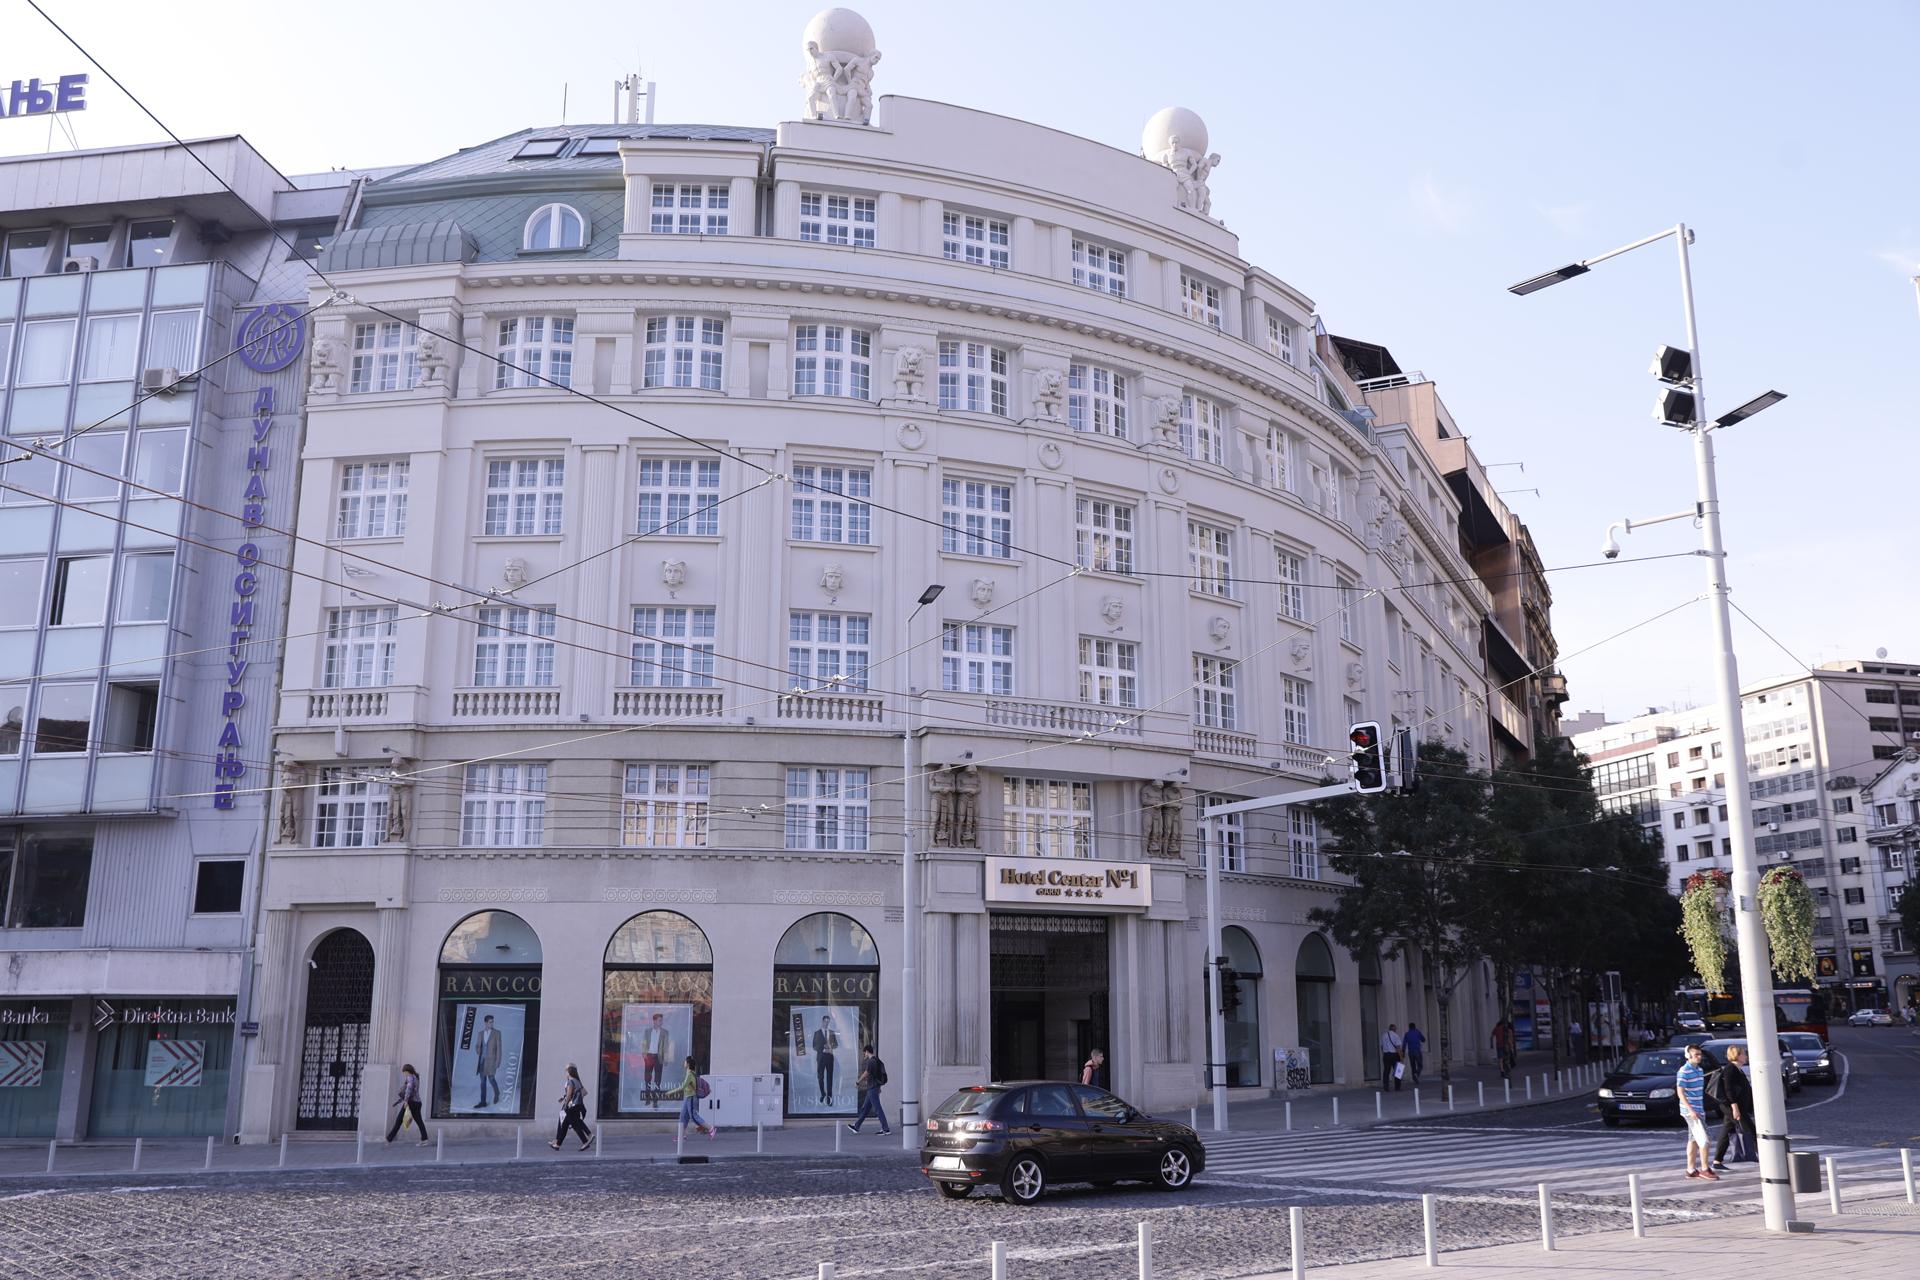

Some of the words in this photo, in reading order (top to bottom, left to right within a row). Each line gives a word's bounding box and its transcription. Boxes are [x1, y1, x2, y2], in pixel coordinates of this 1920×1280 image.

[0, 74, 89, 119] ЊЕ
[243, 387, 275, 527] ДУНАВ
[214, 543, 260, 810] ОСИГУРАЊЕ
[1000, 868, 1046, 885] Hotel
[1048, 870, 1104, 887] Centar
[445, 976, 541, 992] RANCCO
[608, 976, 709, 993] RANCCO
[776, 977, 873, 993] RANCCO
[3, 1006, 49, 1023] Banka
[124, 1006, 191, 1023] Direktna
[196, 1005, 235, 1023] Bank
